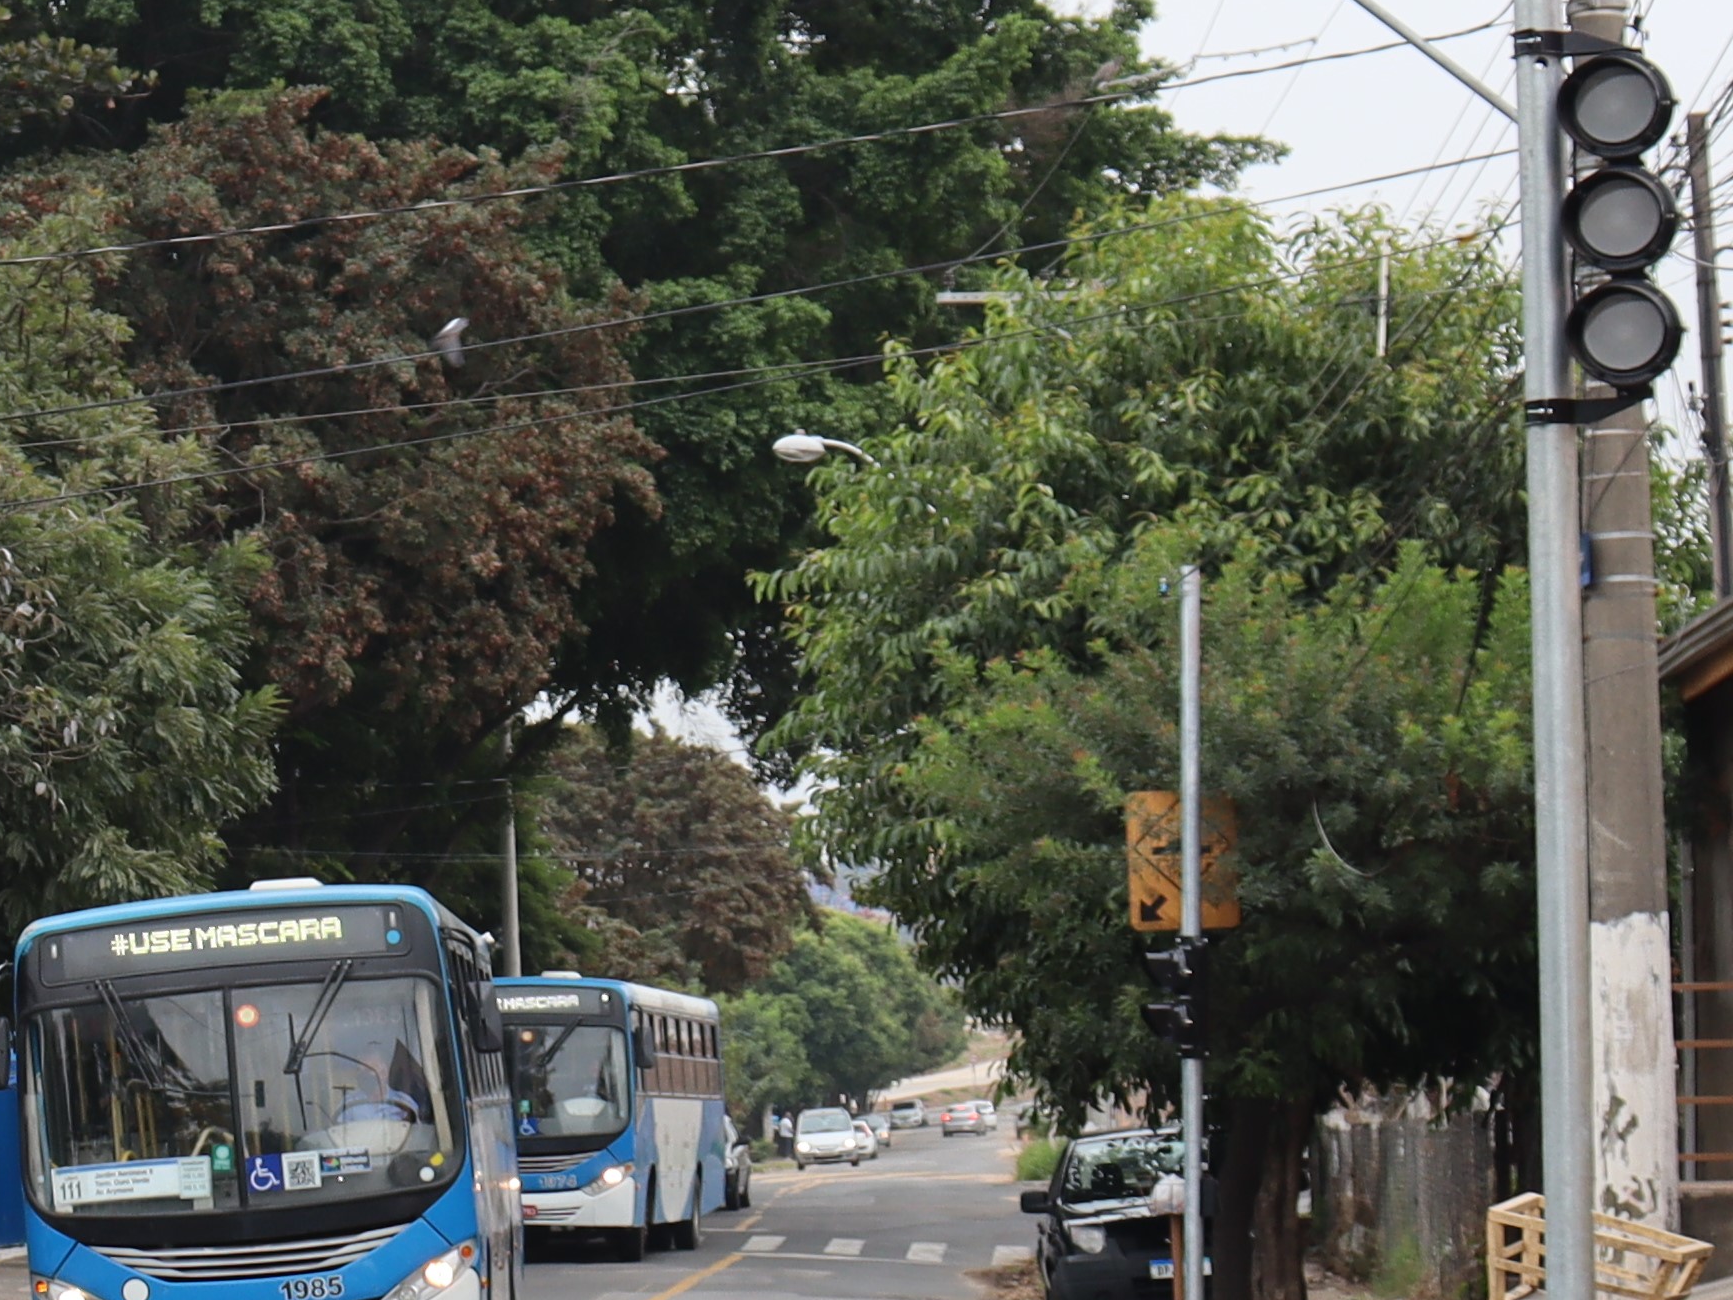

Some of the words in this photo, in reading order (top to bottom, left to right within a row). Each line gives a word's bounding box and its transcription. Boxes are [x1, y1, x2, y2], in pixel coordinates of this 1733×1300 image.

[110, 928, 193, 956] #USE
[195, 916, 343, 950] MASCARA
[60, 1180, 82, 1201] 111
